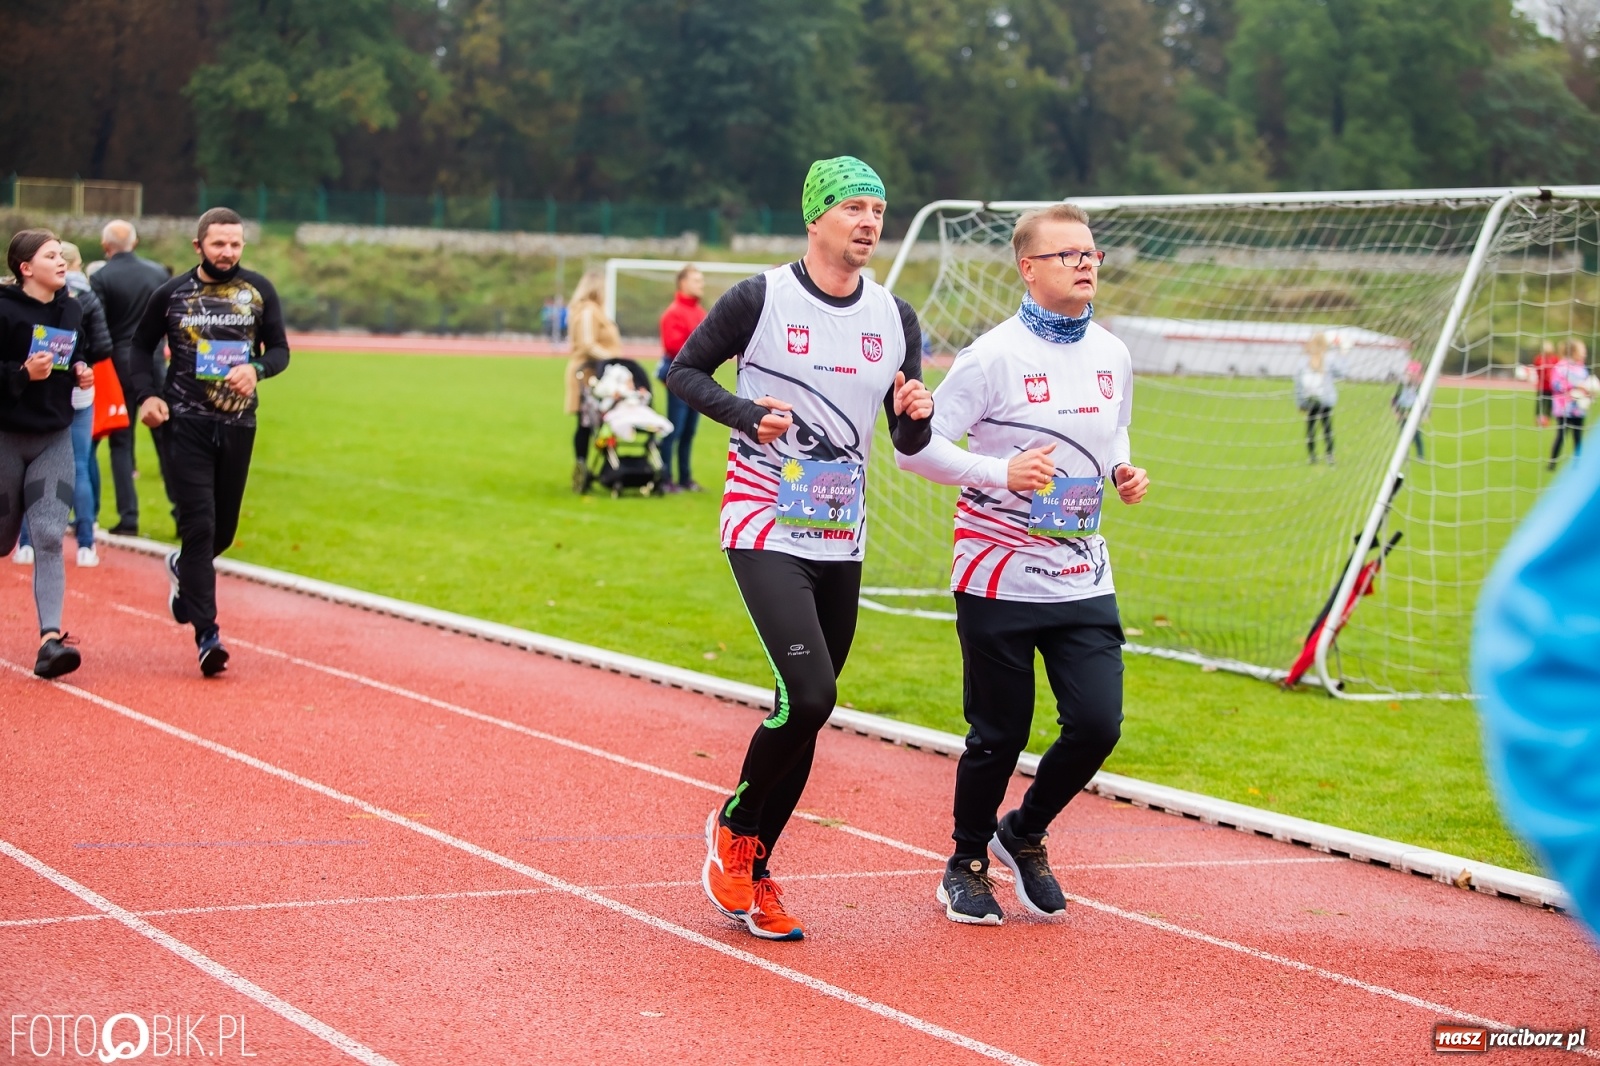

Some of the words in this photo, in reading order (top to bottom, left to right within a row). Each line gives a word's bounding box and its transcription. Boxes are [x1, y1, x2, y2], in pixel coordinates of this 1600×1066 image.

[791, 483, 808, 492] BIEG
[812, 485, 827, 493] DLA
[1043, 497, 1059, 505] BIEG
[1063, 498, 1076, 506] DLA
[828, 507, 851, 522] 091
[1077, 517, 1094, 529] 001
